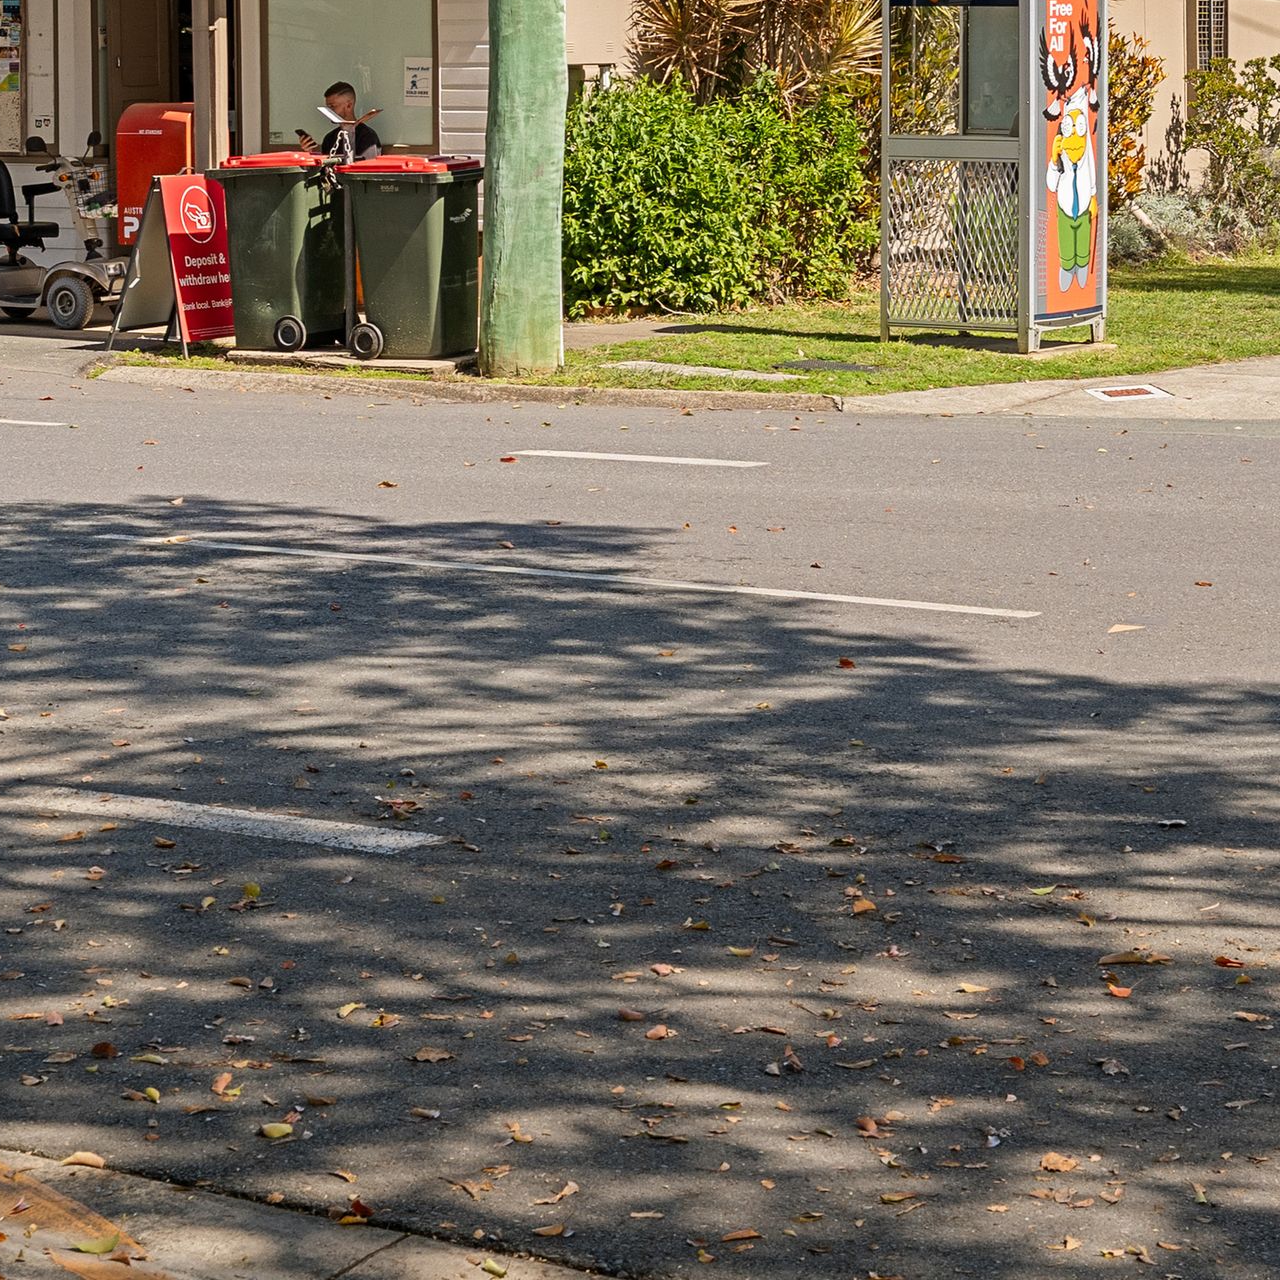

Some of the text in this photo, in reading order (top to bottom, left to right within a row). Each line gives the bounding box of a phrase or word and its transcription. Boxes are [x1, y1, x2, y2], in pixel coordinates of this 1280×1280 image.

[1049, 0, 1073, 16] Free
[1049, 18, 1067, 34] For
[1049, 35, 1064, 52] All
[124, 207, 143, 215] AUSTR
[184, 252, 226, 269] Deposit &
[179, 272, 230, 287] withdraw he
[183, 303, 196, 311] Bank
[212, 298, 233, 309] Bank@P
